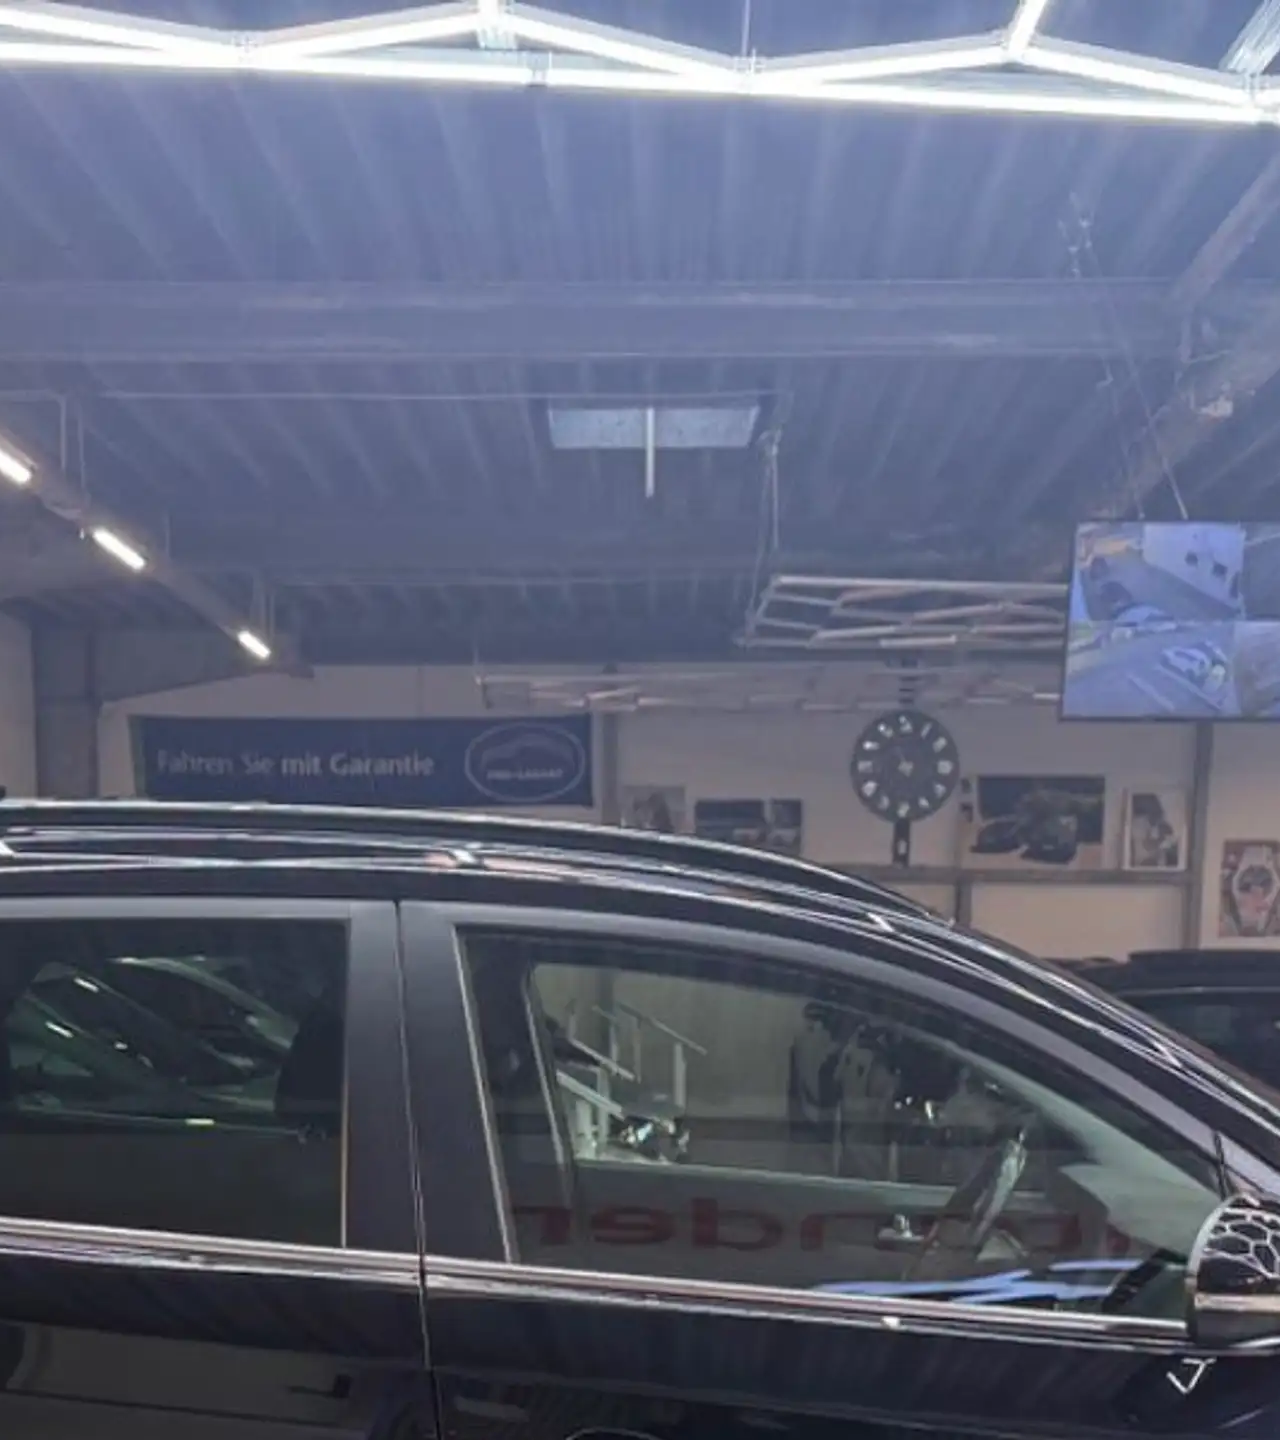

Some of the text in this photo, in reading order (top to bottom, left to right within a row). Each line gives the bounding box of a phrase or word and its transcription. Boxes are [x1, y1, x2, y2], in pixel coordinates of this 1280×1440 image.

[156, 748, 436, 778] Fahren Sie mit Garantie
